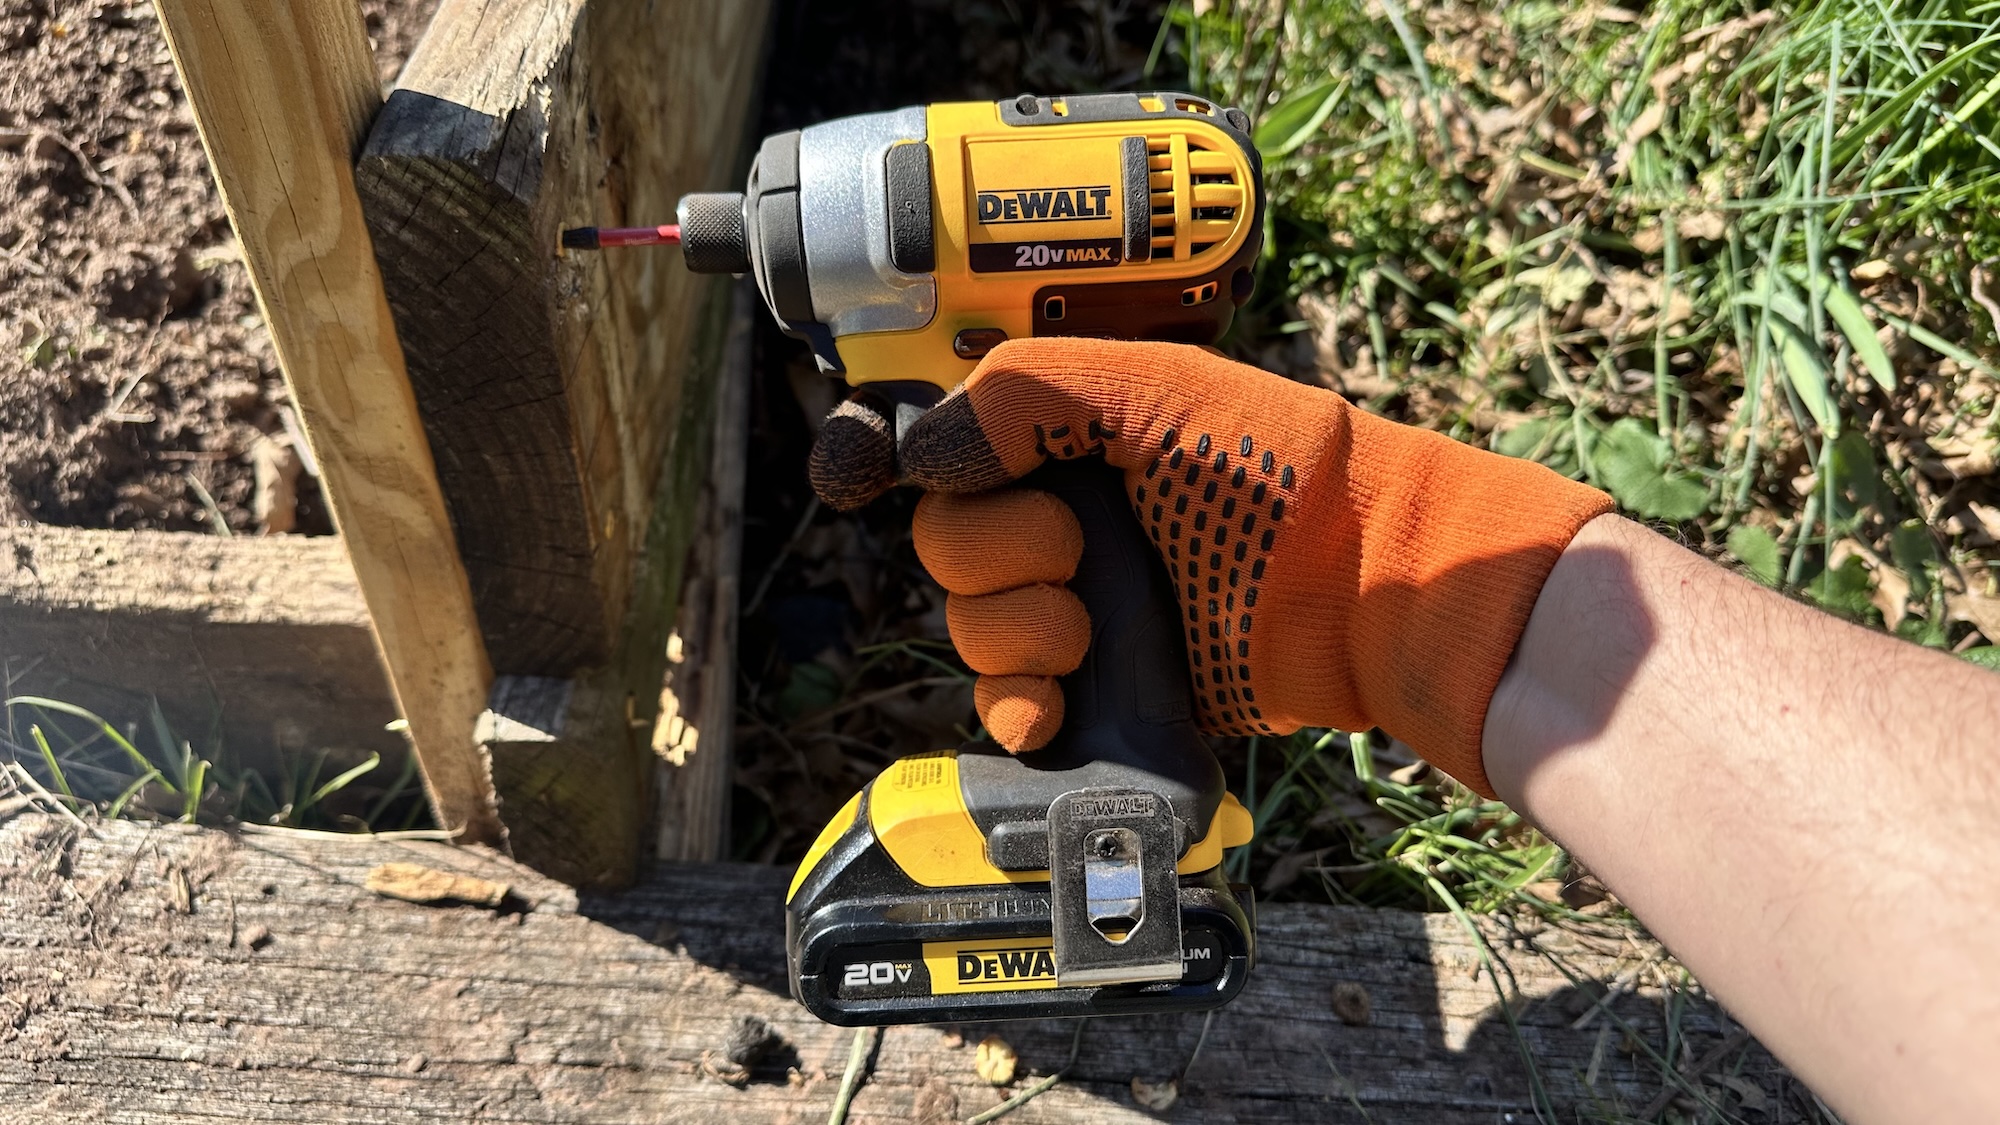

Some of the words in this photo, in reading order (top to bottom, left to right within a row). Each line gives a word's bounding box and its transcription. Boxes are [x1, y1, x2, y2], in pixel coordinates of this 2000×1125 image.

[977, 189, 1111, 220] DEWALT
[1066, 247, 1111, 263] MAX
[1070, 796, 1154, 819] DEWALT
[957, 951, 1056, 980] DEWA
